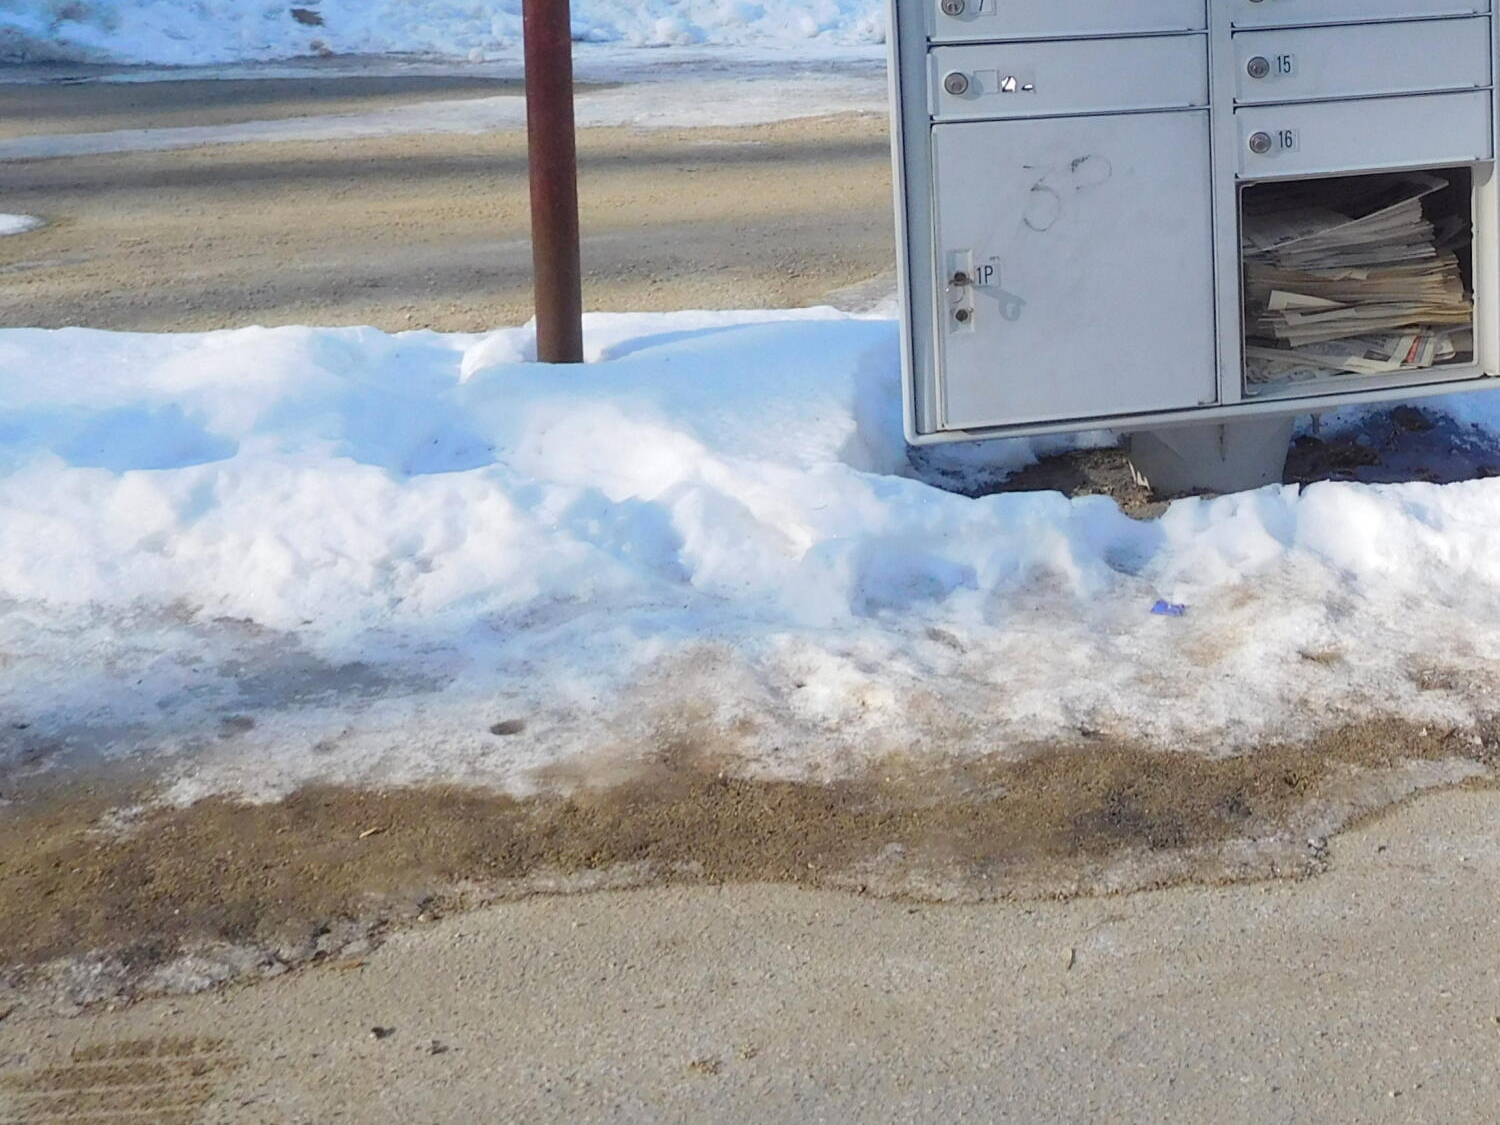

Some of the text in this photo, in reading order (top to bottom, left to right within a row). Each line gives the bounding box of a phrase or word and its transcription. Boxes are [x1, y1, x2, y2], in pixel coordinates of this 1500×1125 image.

[1276, 55, 1292, 74] 15
[1278, 130, 1294, 148] 16
[976, 265, 994, 284] 1P
